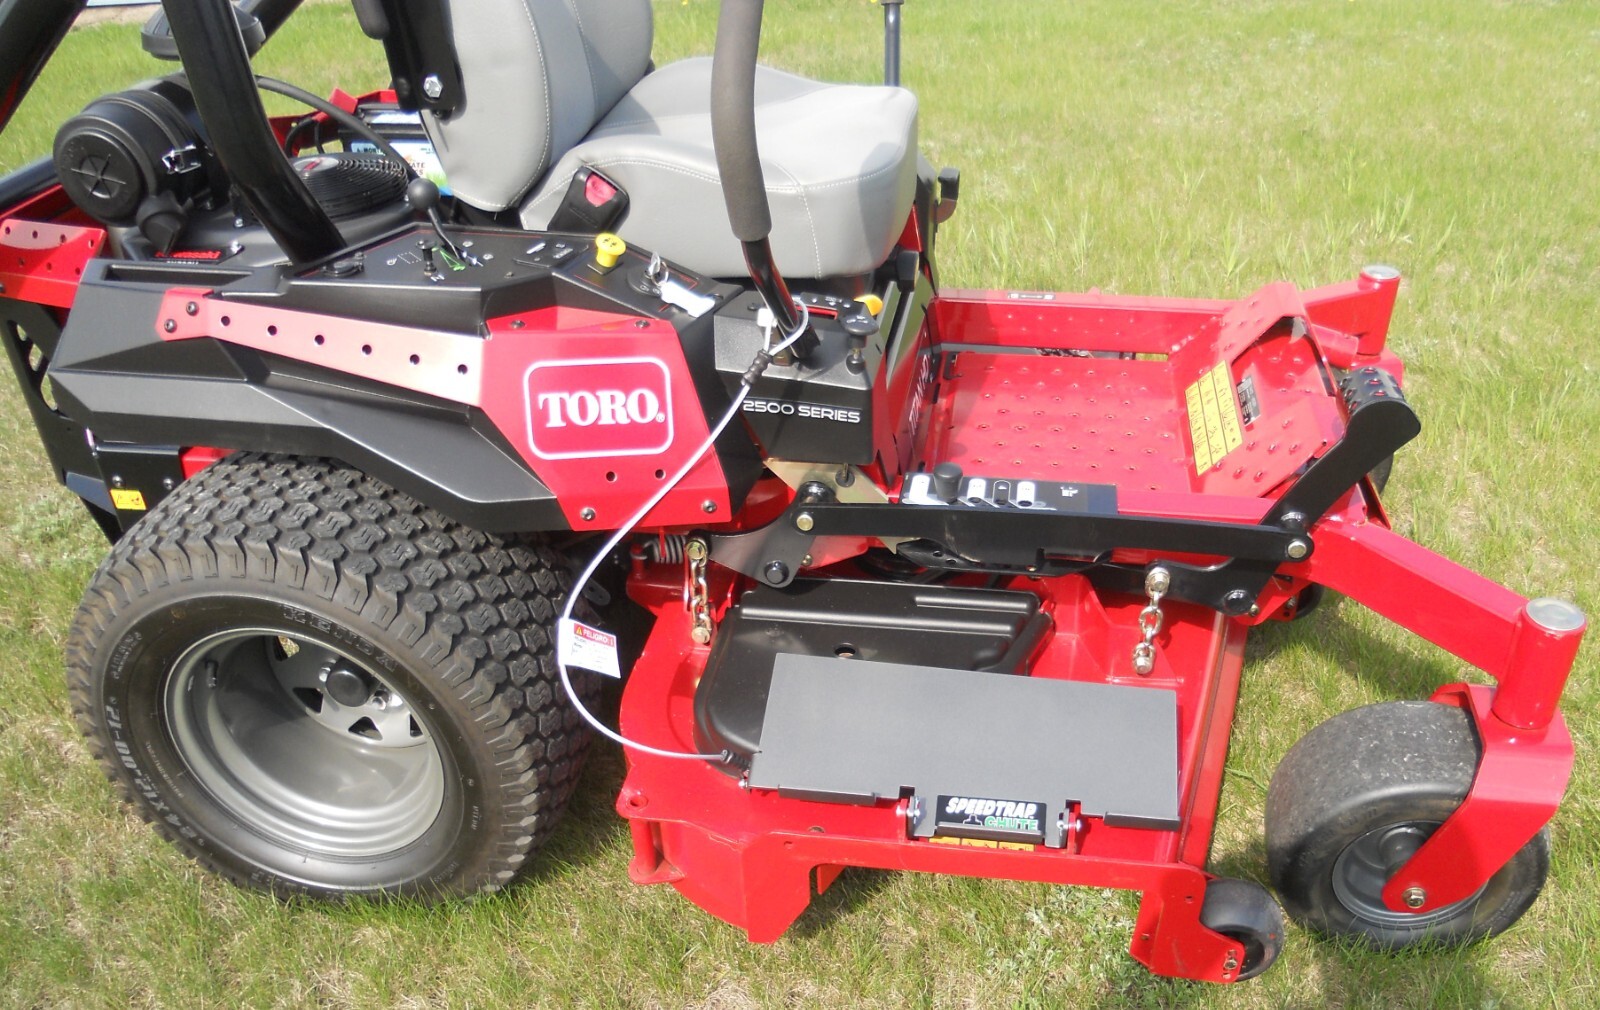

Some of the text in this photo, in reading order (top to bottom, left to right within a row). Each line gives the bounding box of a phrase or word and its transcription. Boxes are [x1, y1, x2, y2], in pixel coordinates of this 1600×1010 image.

[538, 388, 660, 428] TORO
[742, 399, 861, 424] 2500 SERIES
[984, 816, 1039, 831] CHUTE
